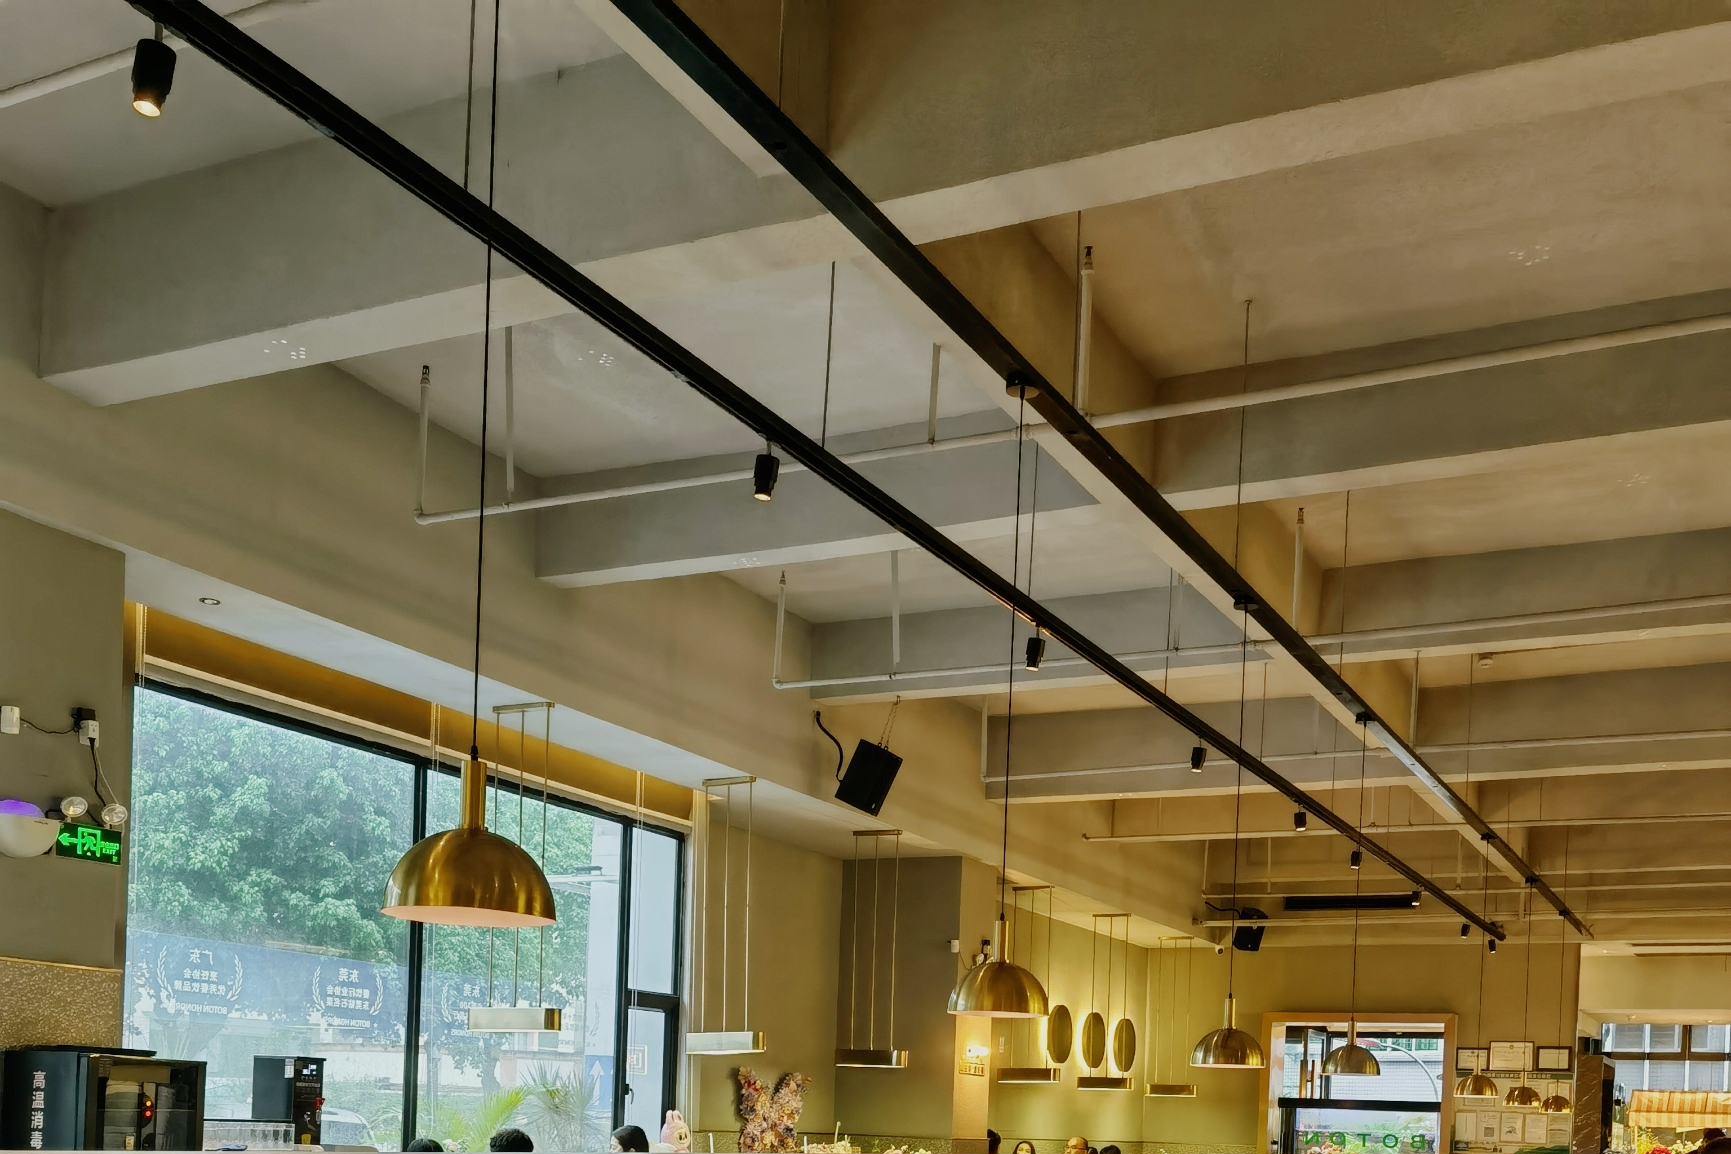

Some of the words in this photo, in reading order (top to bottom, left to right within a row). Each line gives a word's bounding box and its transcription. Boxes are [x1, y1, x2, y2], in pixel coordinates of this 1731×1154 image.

[102, 847, 117, 856] EXIT
[29, 1070, 47, 1150] 高温消毒
